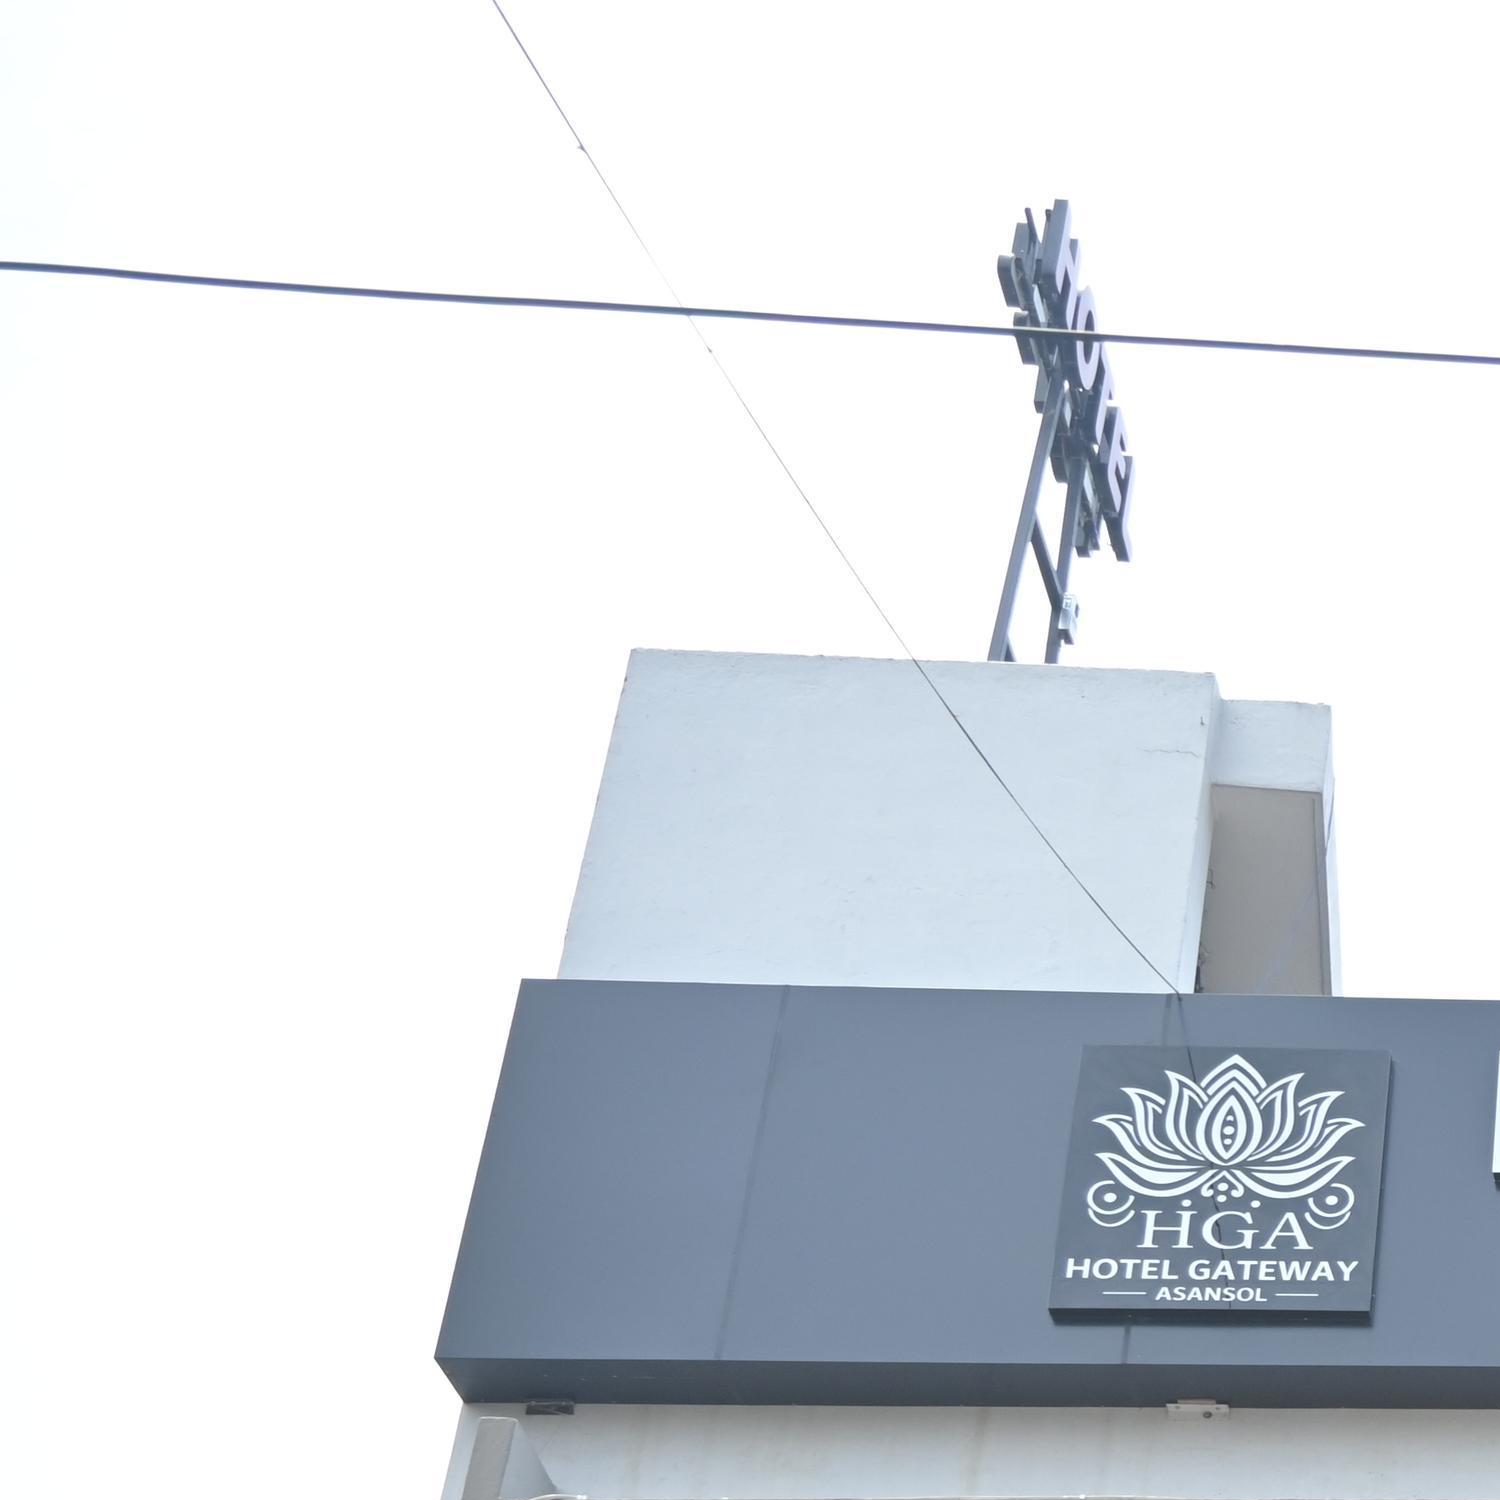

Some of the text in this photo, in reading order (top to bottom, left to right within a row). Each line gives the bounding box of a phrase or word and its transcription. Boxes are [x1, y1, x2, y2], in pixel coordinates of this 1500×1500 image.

[1136, 1206, 1315, 1251] HGA
[1065, 1257, 1360, 1283] HOTEL GATEWAY
[1154, 1286, 1268, 1303] ASANSOL
